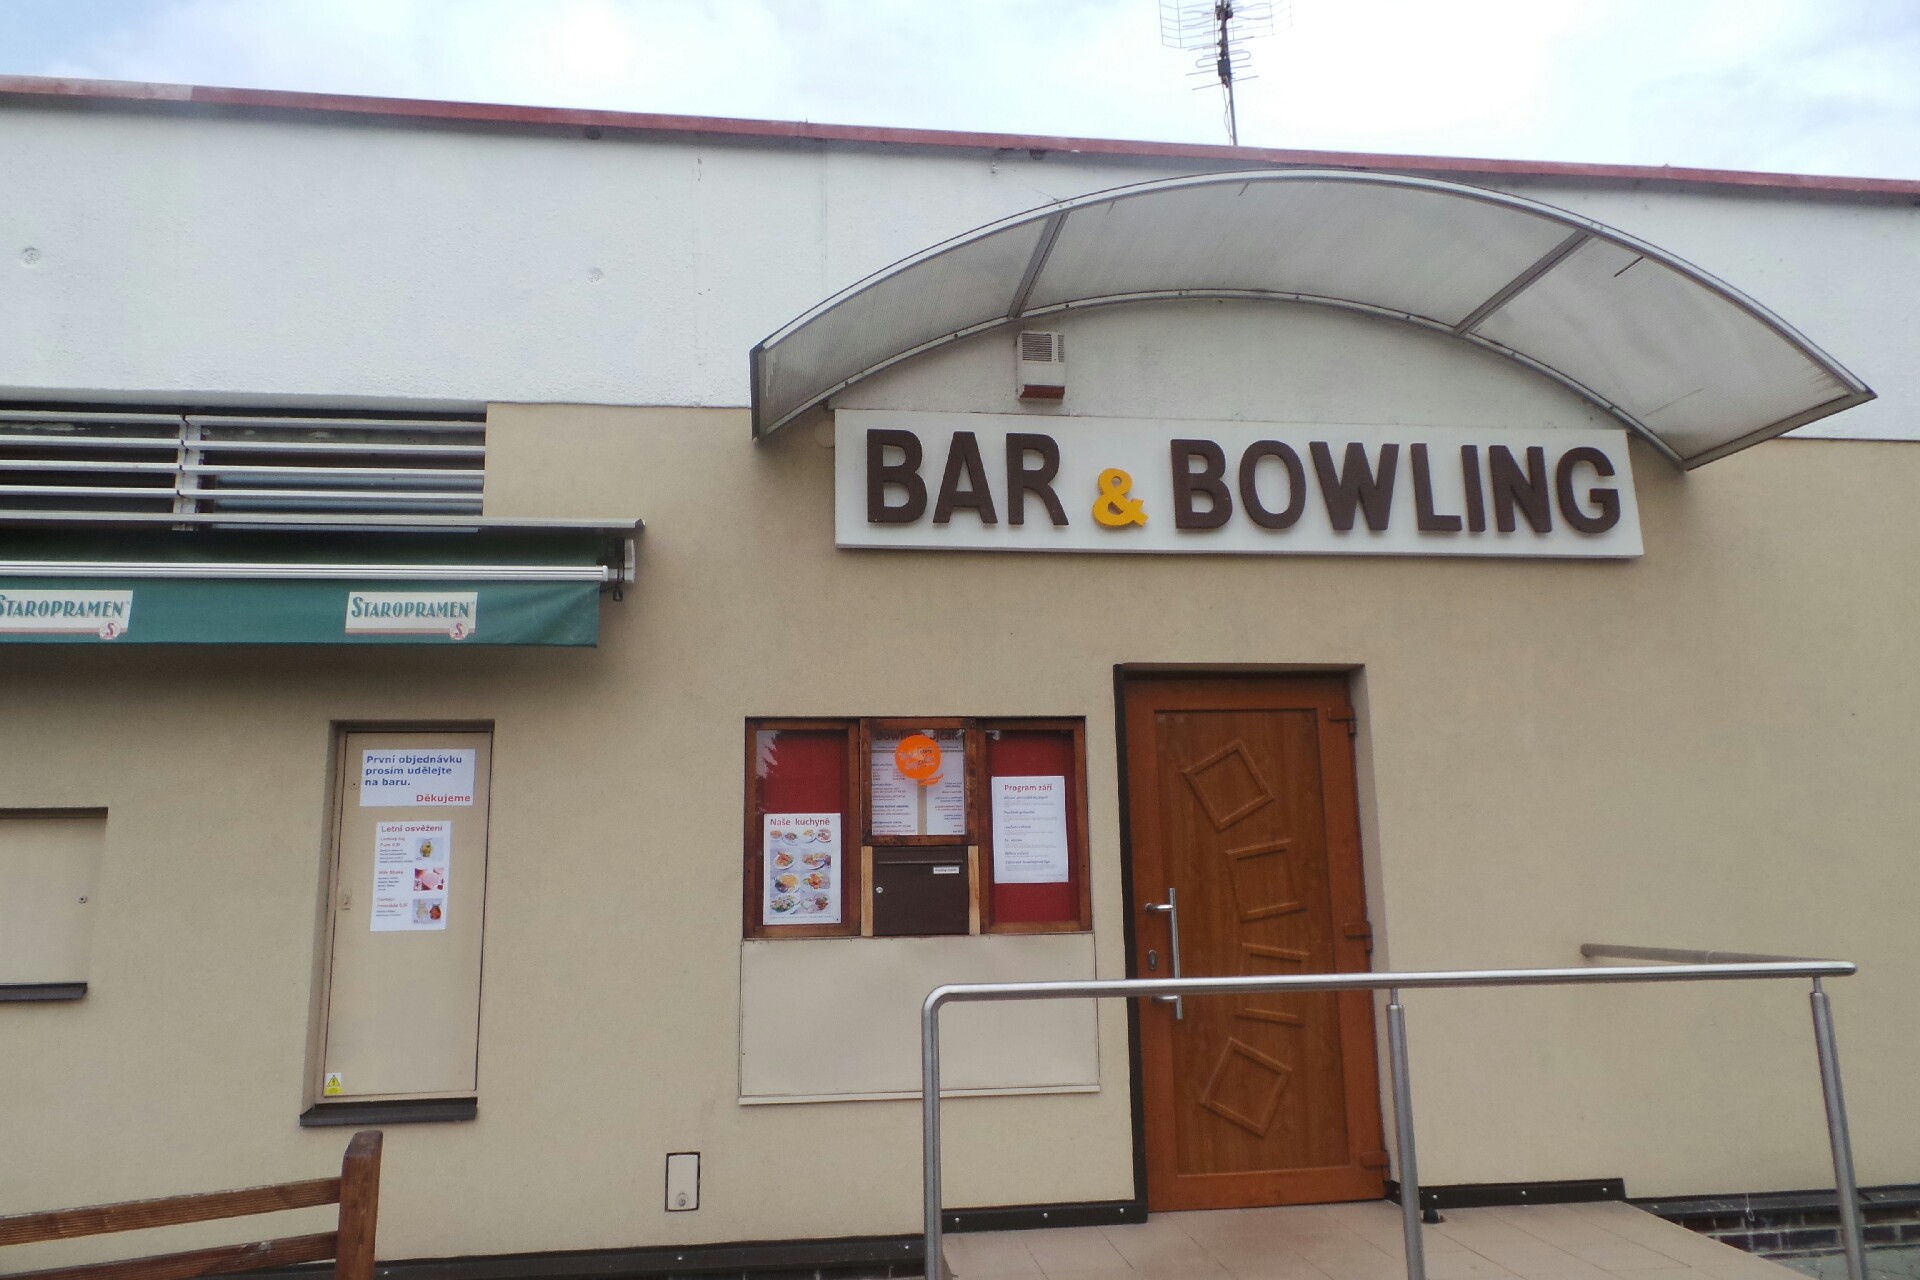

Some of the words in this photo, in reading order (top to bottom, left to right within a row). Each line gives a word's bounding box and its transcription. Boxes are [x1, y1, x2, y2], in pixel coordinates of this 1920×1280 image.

[866, 428, 1068, 526] BAR
[1092, 467, 1149, 528] &
[1170, 438, 1622, 534] BOWLING
[351, 596, 469, 618] STAROPRAMEN
[366, 754, 396, 764] První
[398, 754, 462, 765] objednávku
[365, 766, 404, 776] prosím
[407, 766, 452, 776] udělejte
[382, 778, 411, 786] baru.
[1004, 784, 1037, 793] Program
[416, 793, 471, 804] Děkujeme
[770, 817, 791, 826] Naše
[795, 817, 831, 827] kuchyně
[381, 824, 403, 833] Letní
[404, 823, 443, 832] osvěžení
